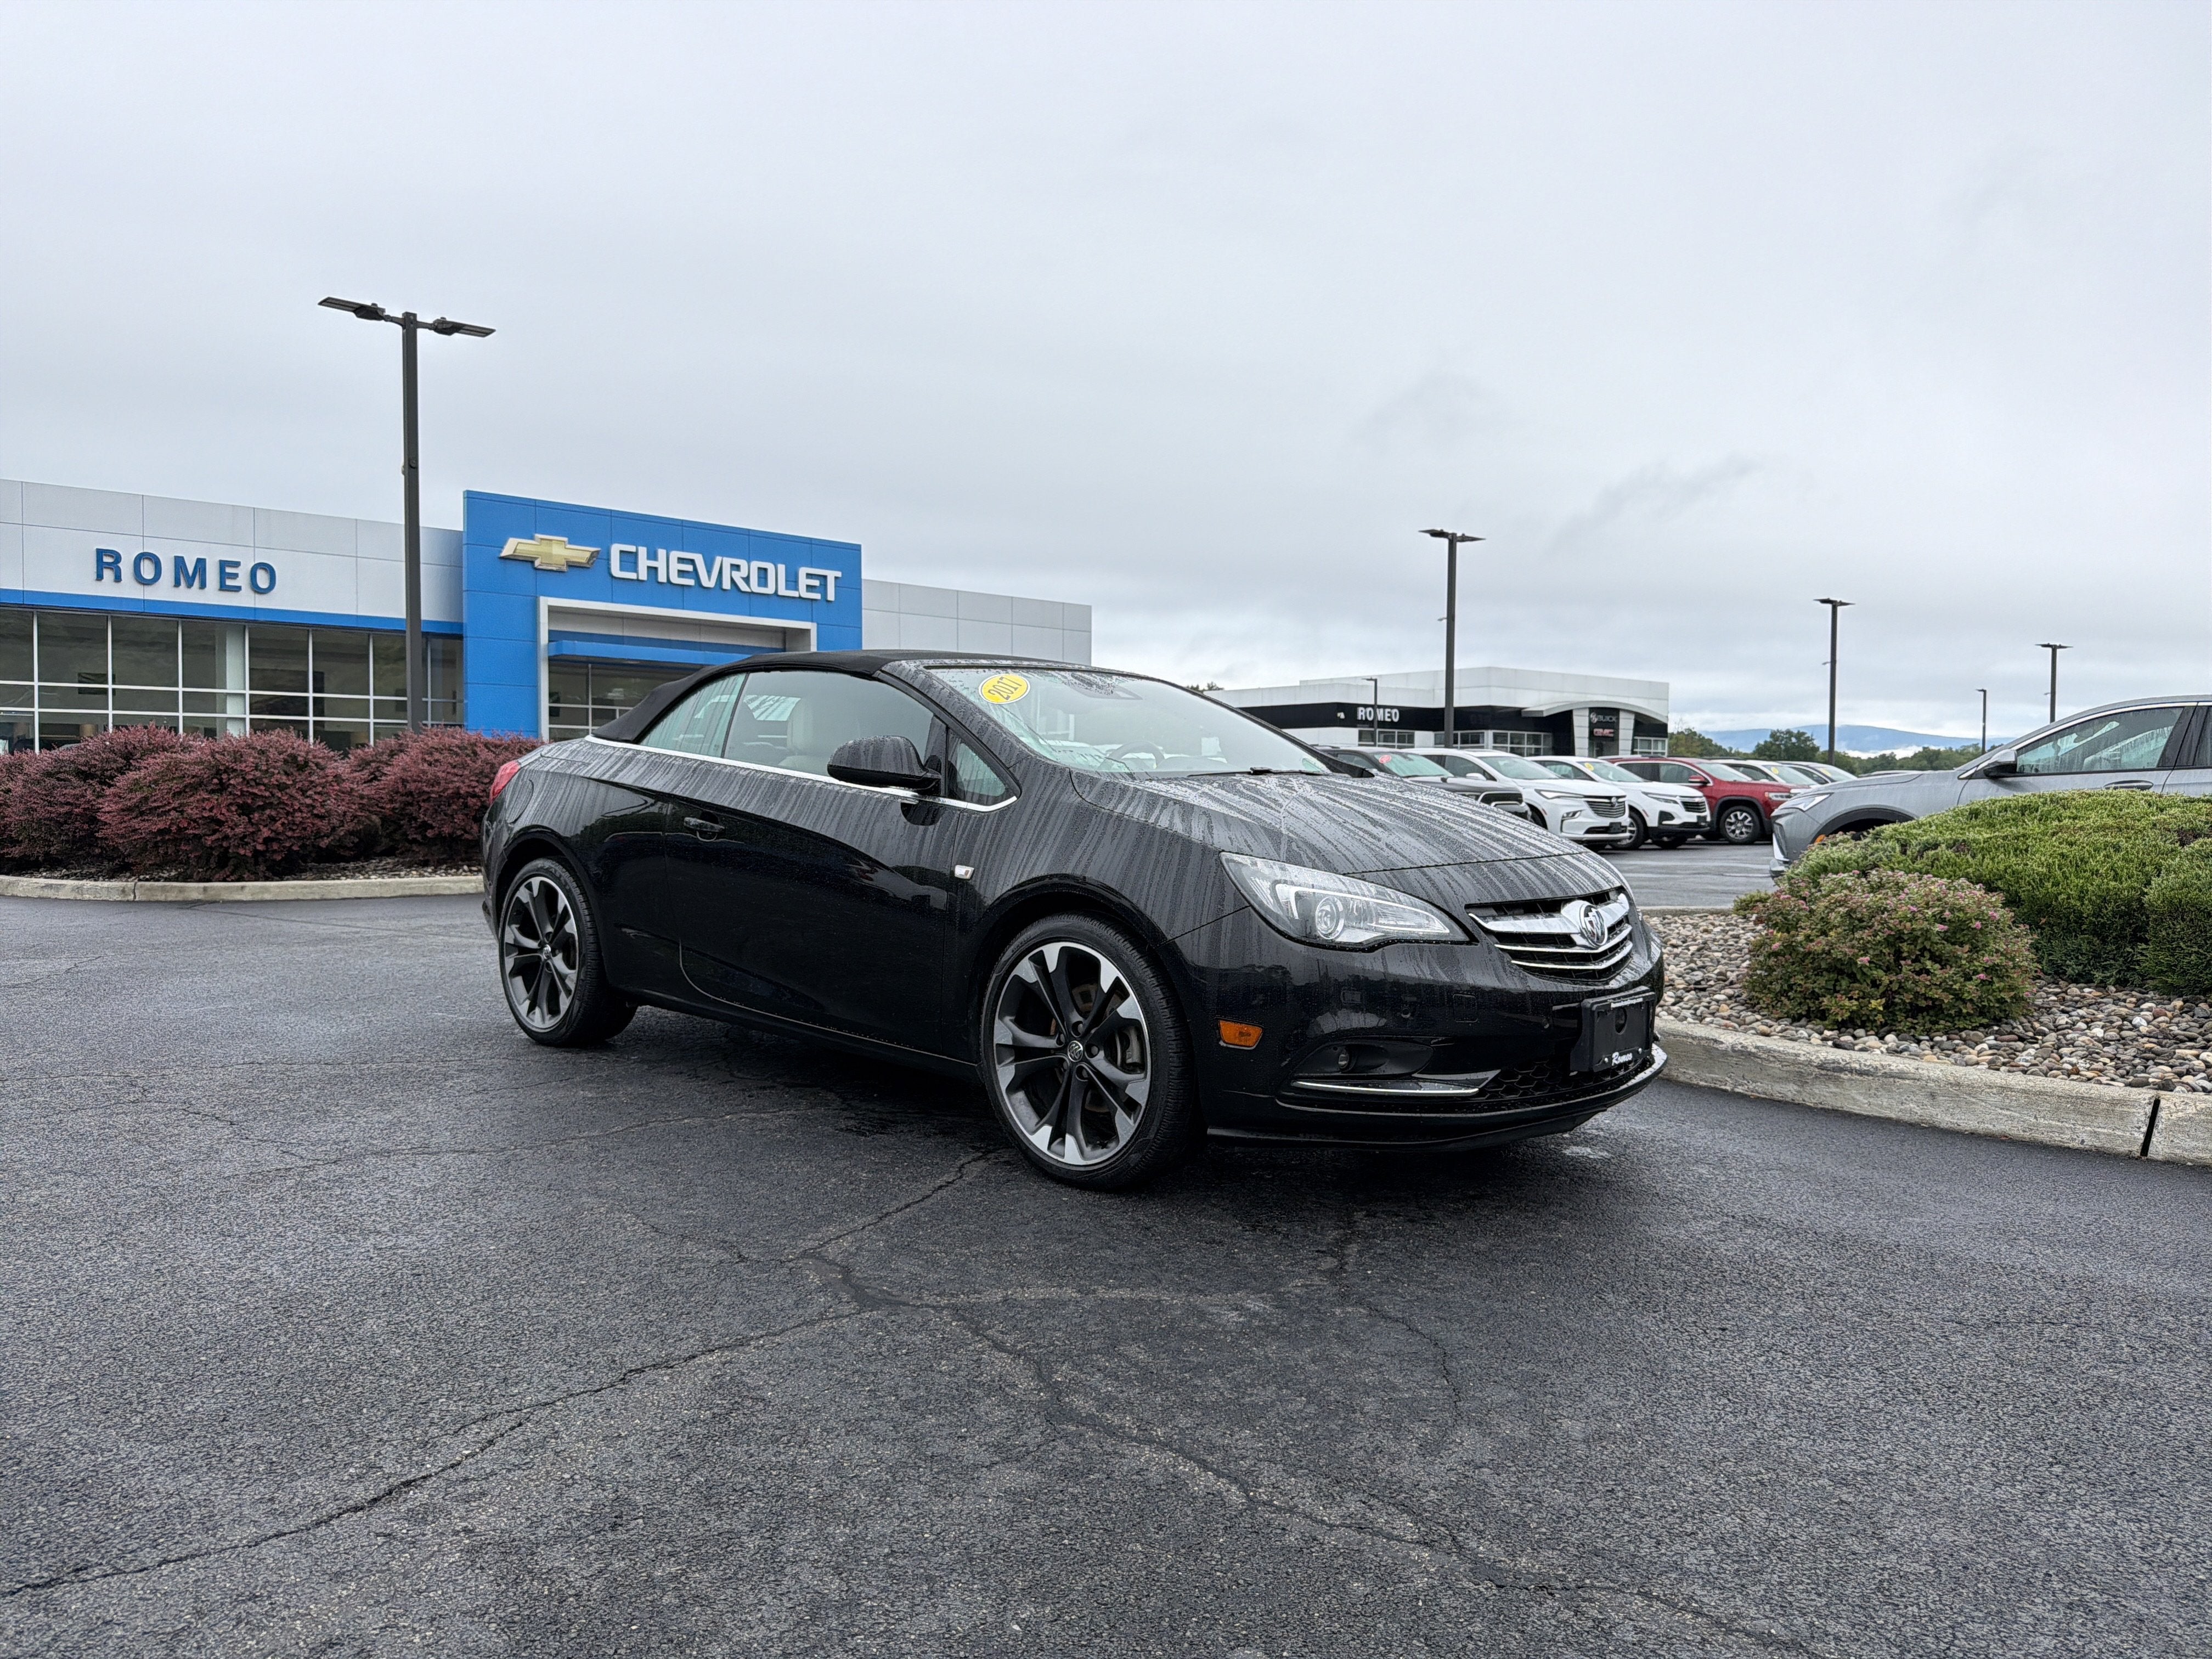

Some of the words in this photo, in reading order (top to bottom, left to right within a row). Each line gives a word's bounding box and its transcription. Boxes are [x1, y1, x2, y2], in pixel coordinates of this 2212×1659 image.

[95, 548, 277, 594] ROMEO
[611, 543, 842, 601] CHEVROLET
[988, 676, 1022, 701] 2017
[1357, 707, 1400, 723] ROMEO
